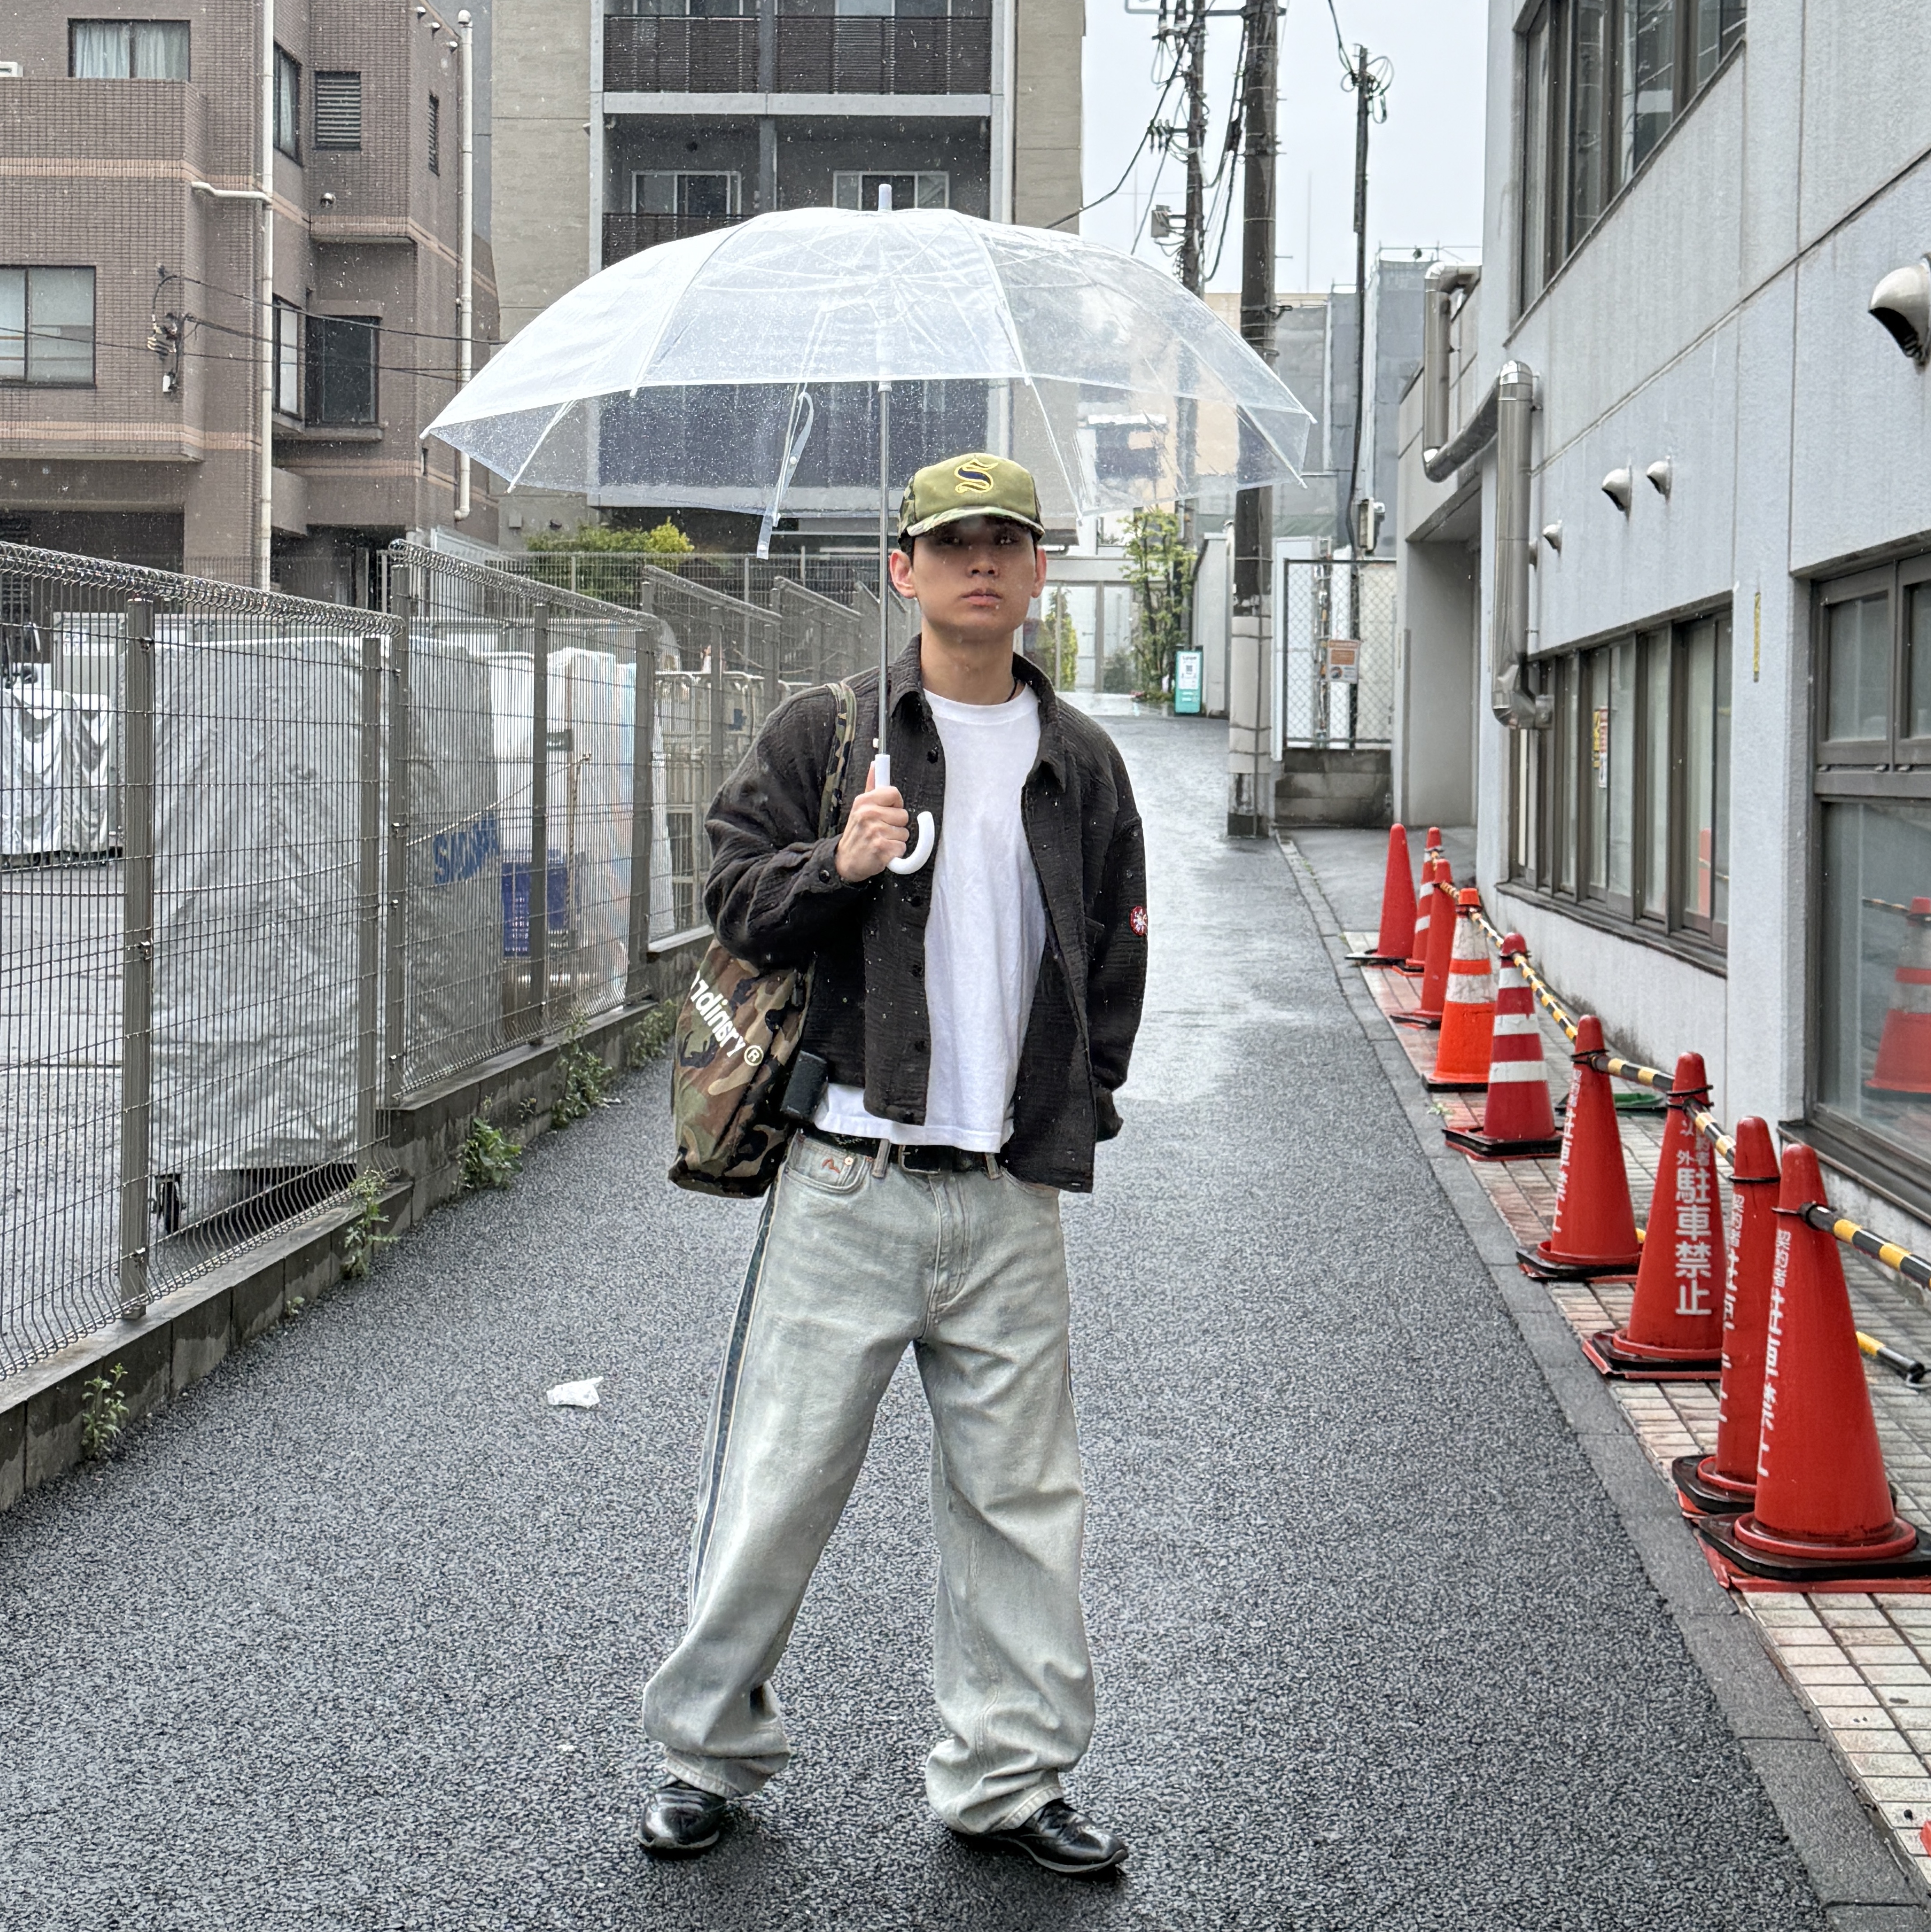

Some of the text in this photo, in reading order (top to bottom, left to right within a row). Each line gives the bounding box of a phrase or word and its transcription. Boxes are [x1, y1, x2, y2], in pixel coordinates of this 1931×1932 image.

[954, 458, 999, 493] S
[1675, 1168, 1712, 1315] 駐車禁止
